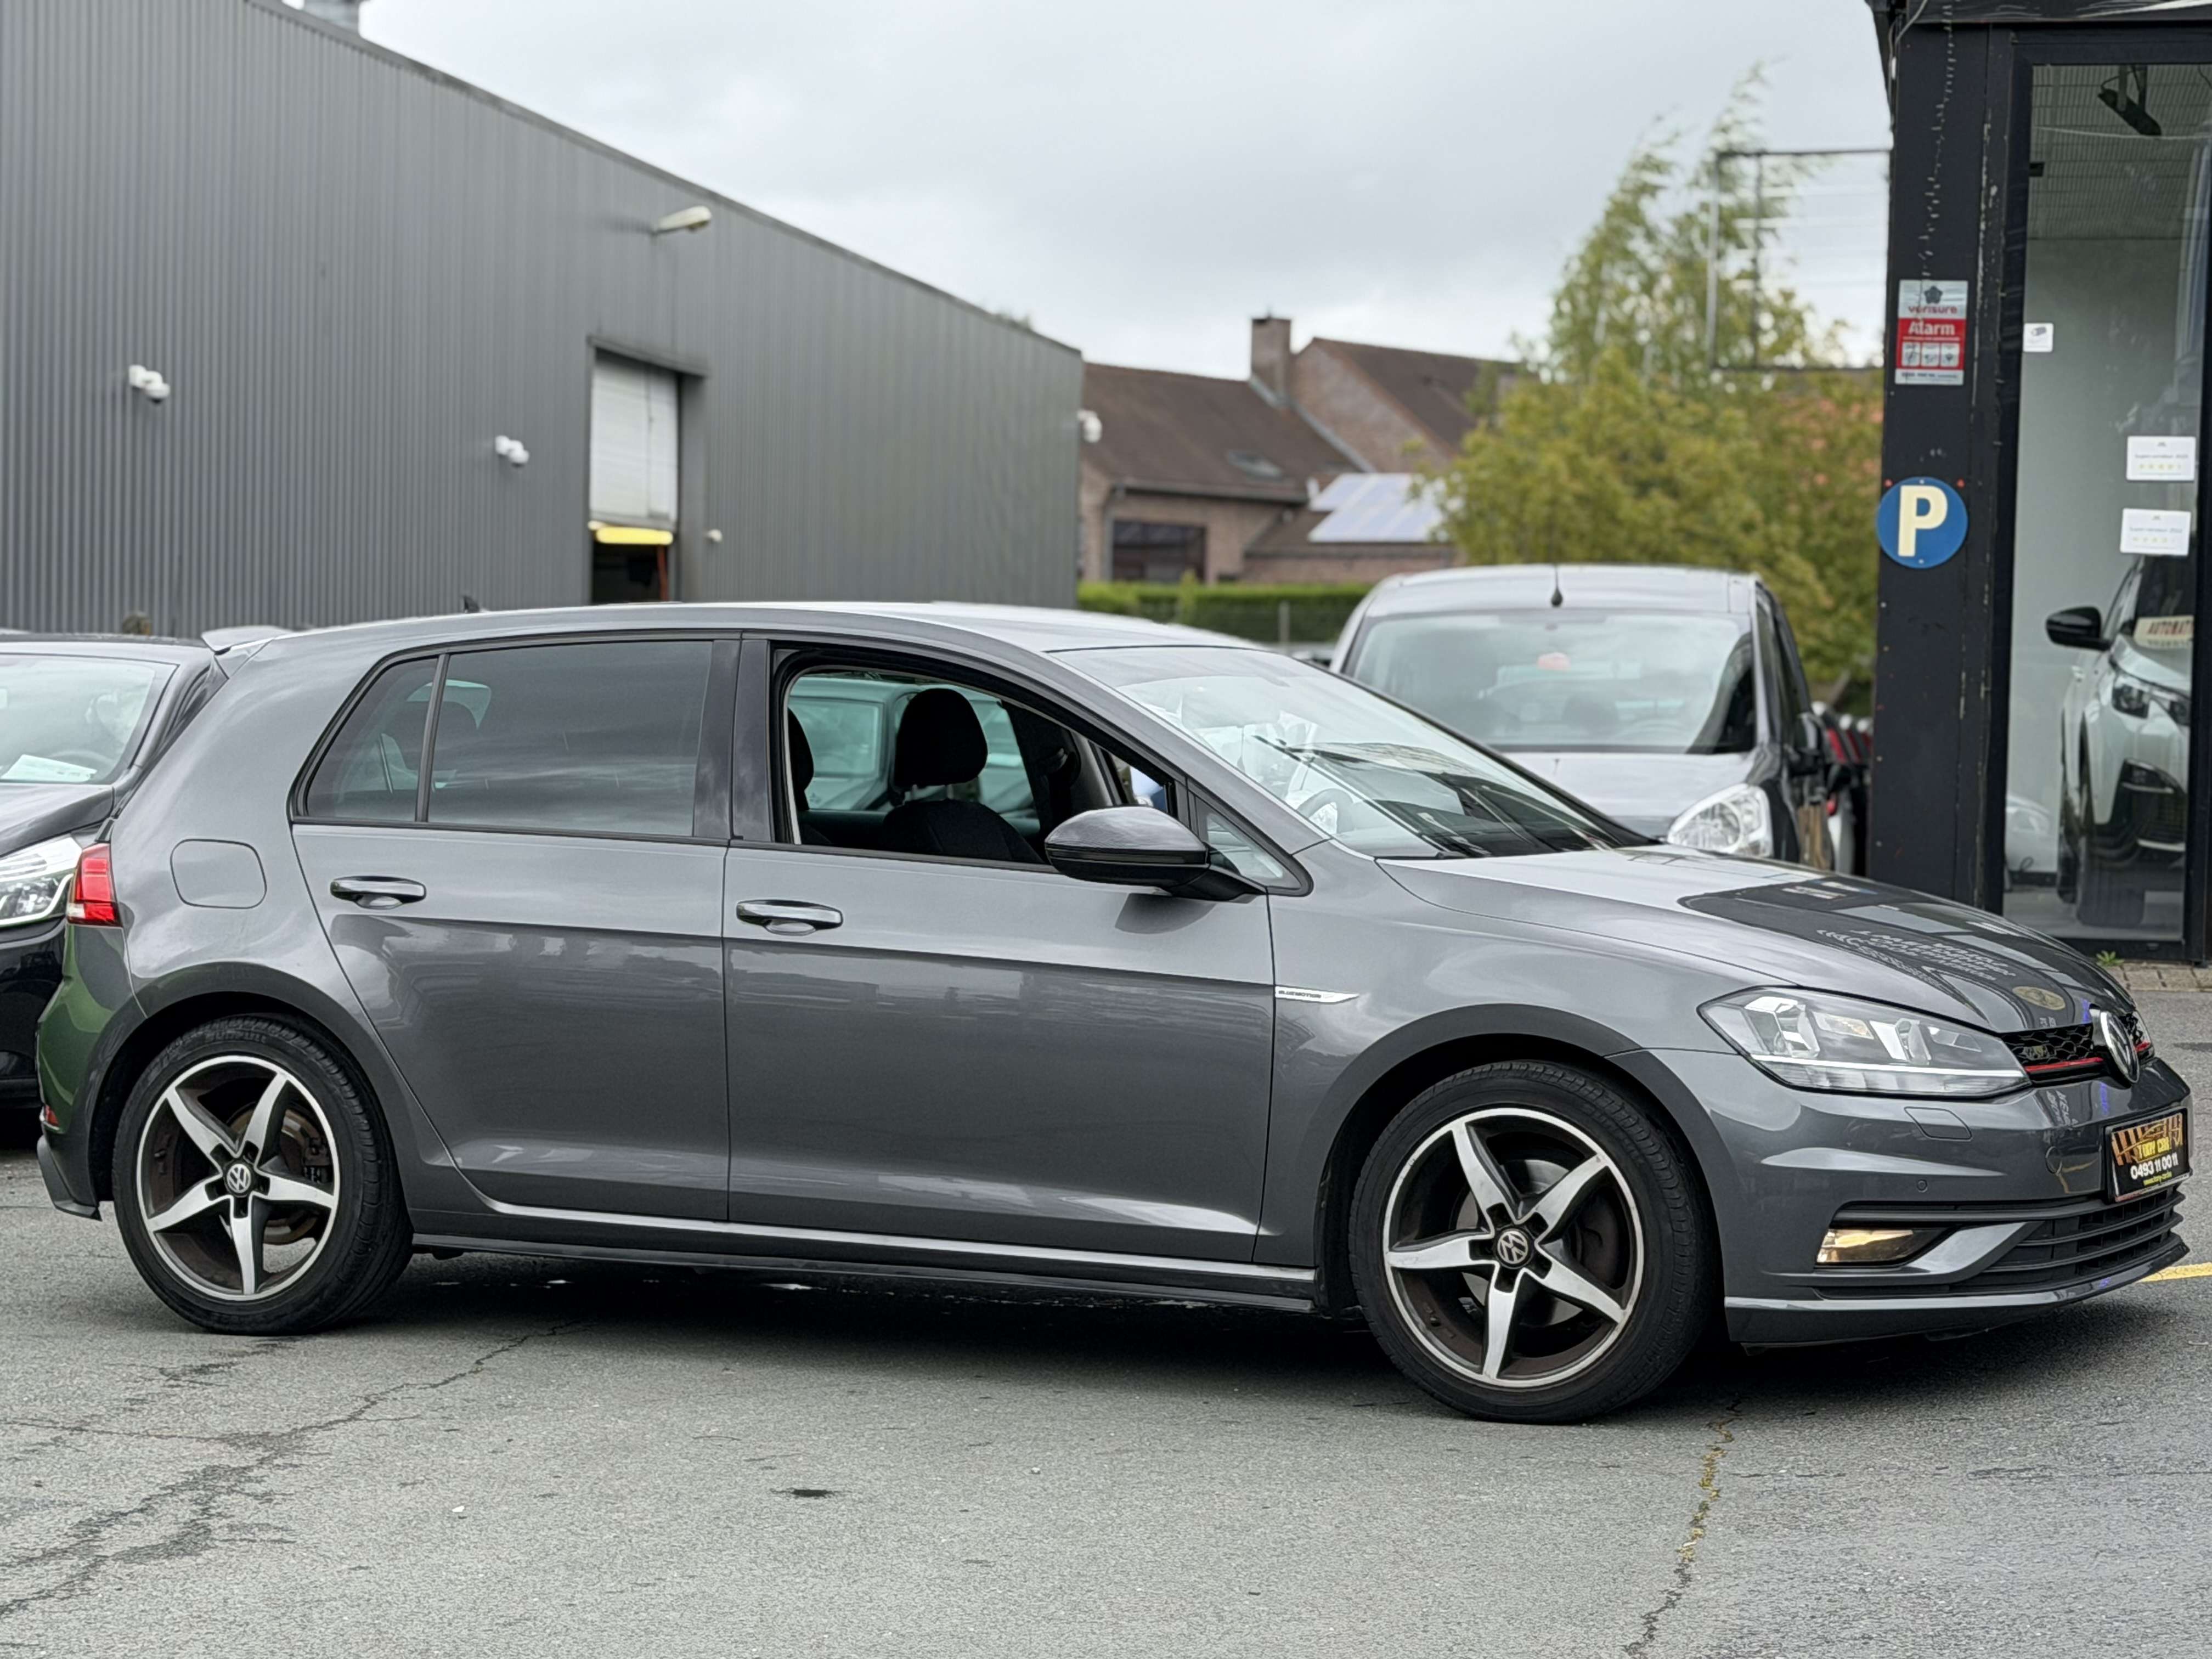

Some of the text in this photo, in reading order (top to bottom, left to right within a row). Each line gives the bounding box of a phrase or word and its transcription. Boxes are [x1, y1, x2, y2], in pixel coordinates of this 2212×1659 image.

[1908, 320, 1955, 335] Alarm
[1898, 485, 1948, 557] P
[2130, 1161, 2154, 1180] 0493
[2162, 1154, 2172, 1170] 00
